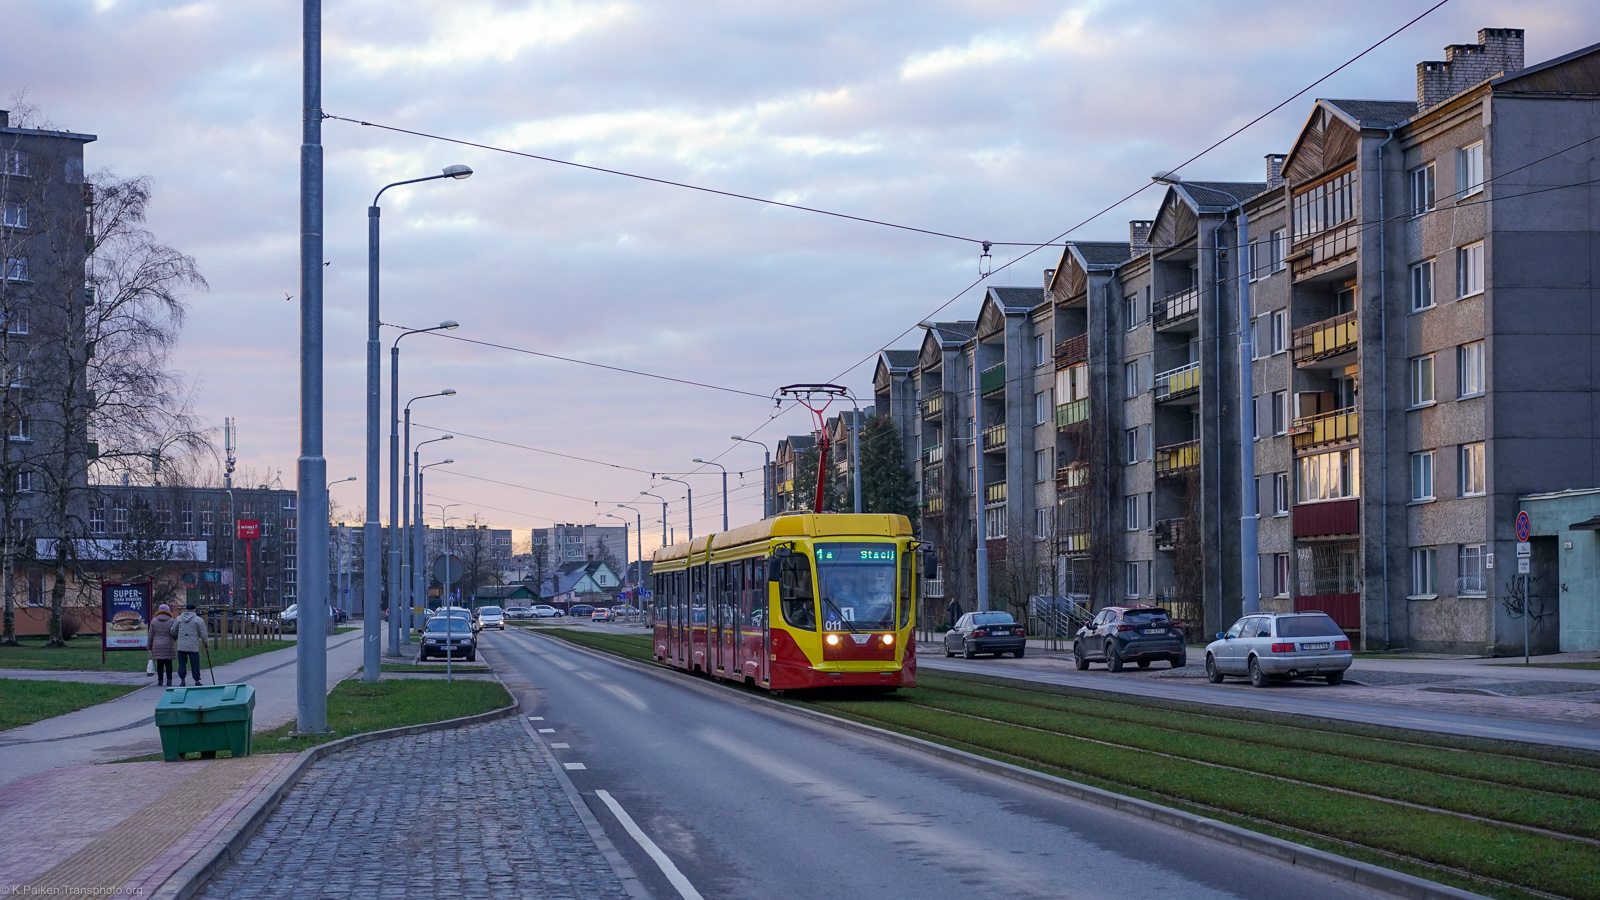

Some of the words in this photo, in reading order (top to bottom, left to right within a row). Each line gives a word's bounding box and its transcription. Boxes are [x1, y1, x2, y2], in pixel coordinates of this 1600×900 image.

[113, 589, 142, 598] SUPER-
[844, 608, 851, 621] 1
[825, 620, 842, 631] 011
